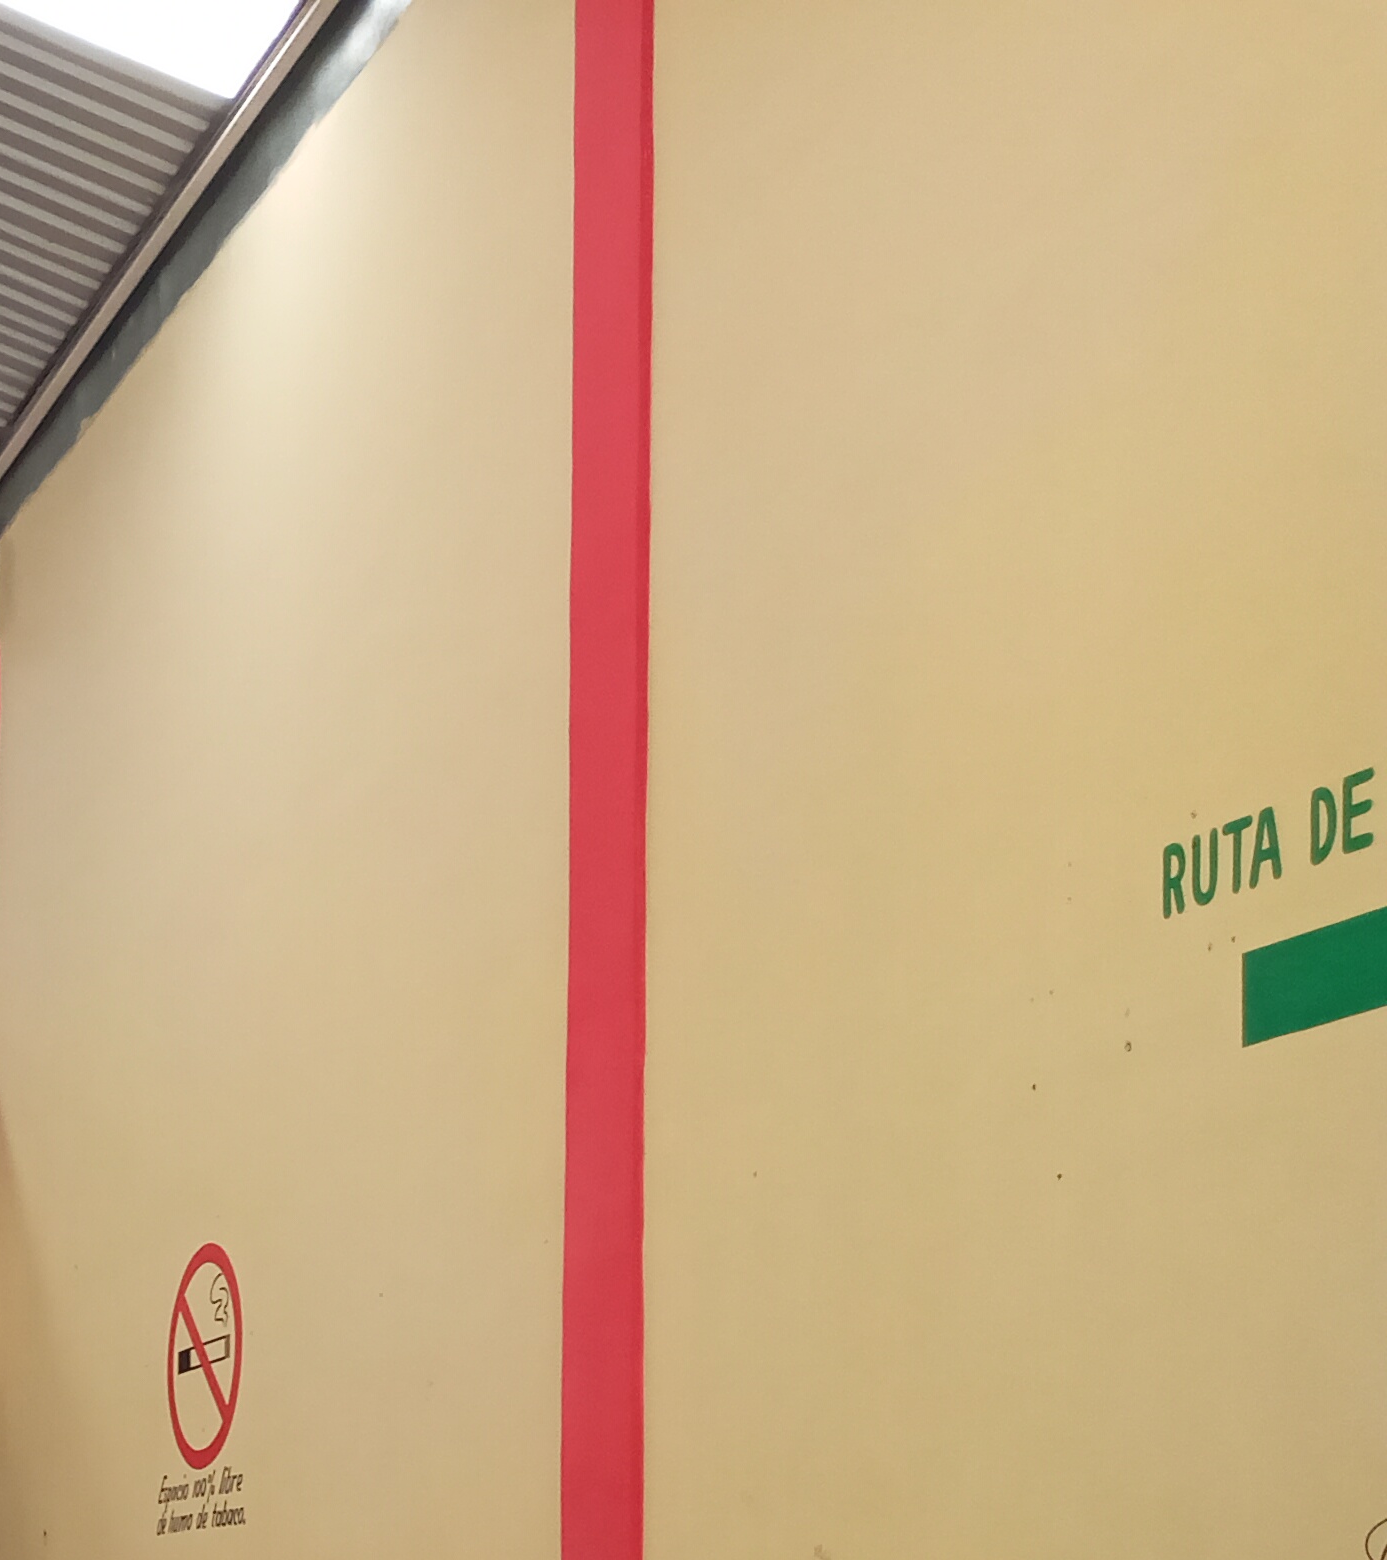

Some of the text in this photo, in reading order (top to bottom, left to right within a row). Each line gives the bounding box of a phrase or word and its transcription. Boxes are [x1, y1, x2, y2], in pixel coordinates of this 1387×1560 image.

[1162, 766, 1375, 919] RUTA DE
[192, 1469, 216, 1503] 100%
[218, 1466, 243, 1494] libre
[196, 1504, 208, 1529] de
